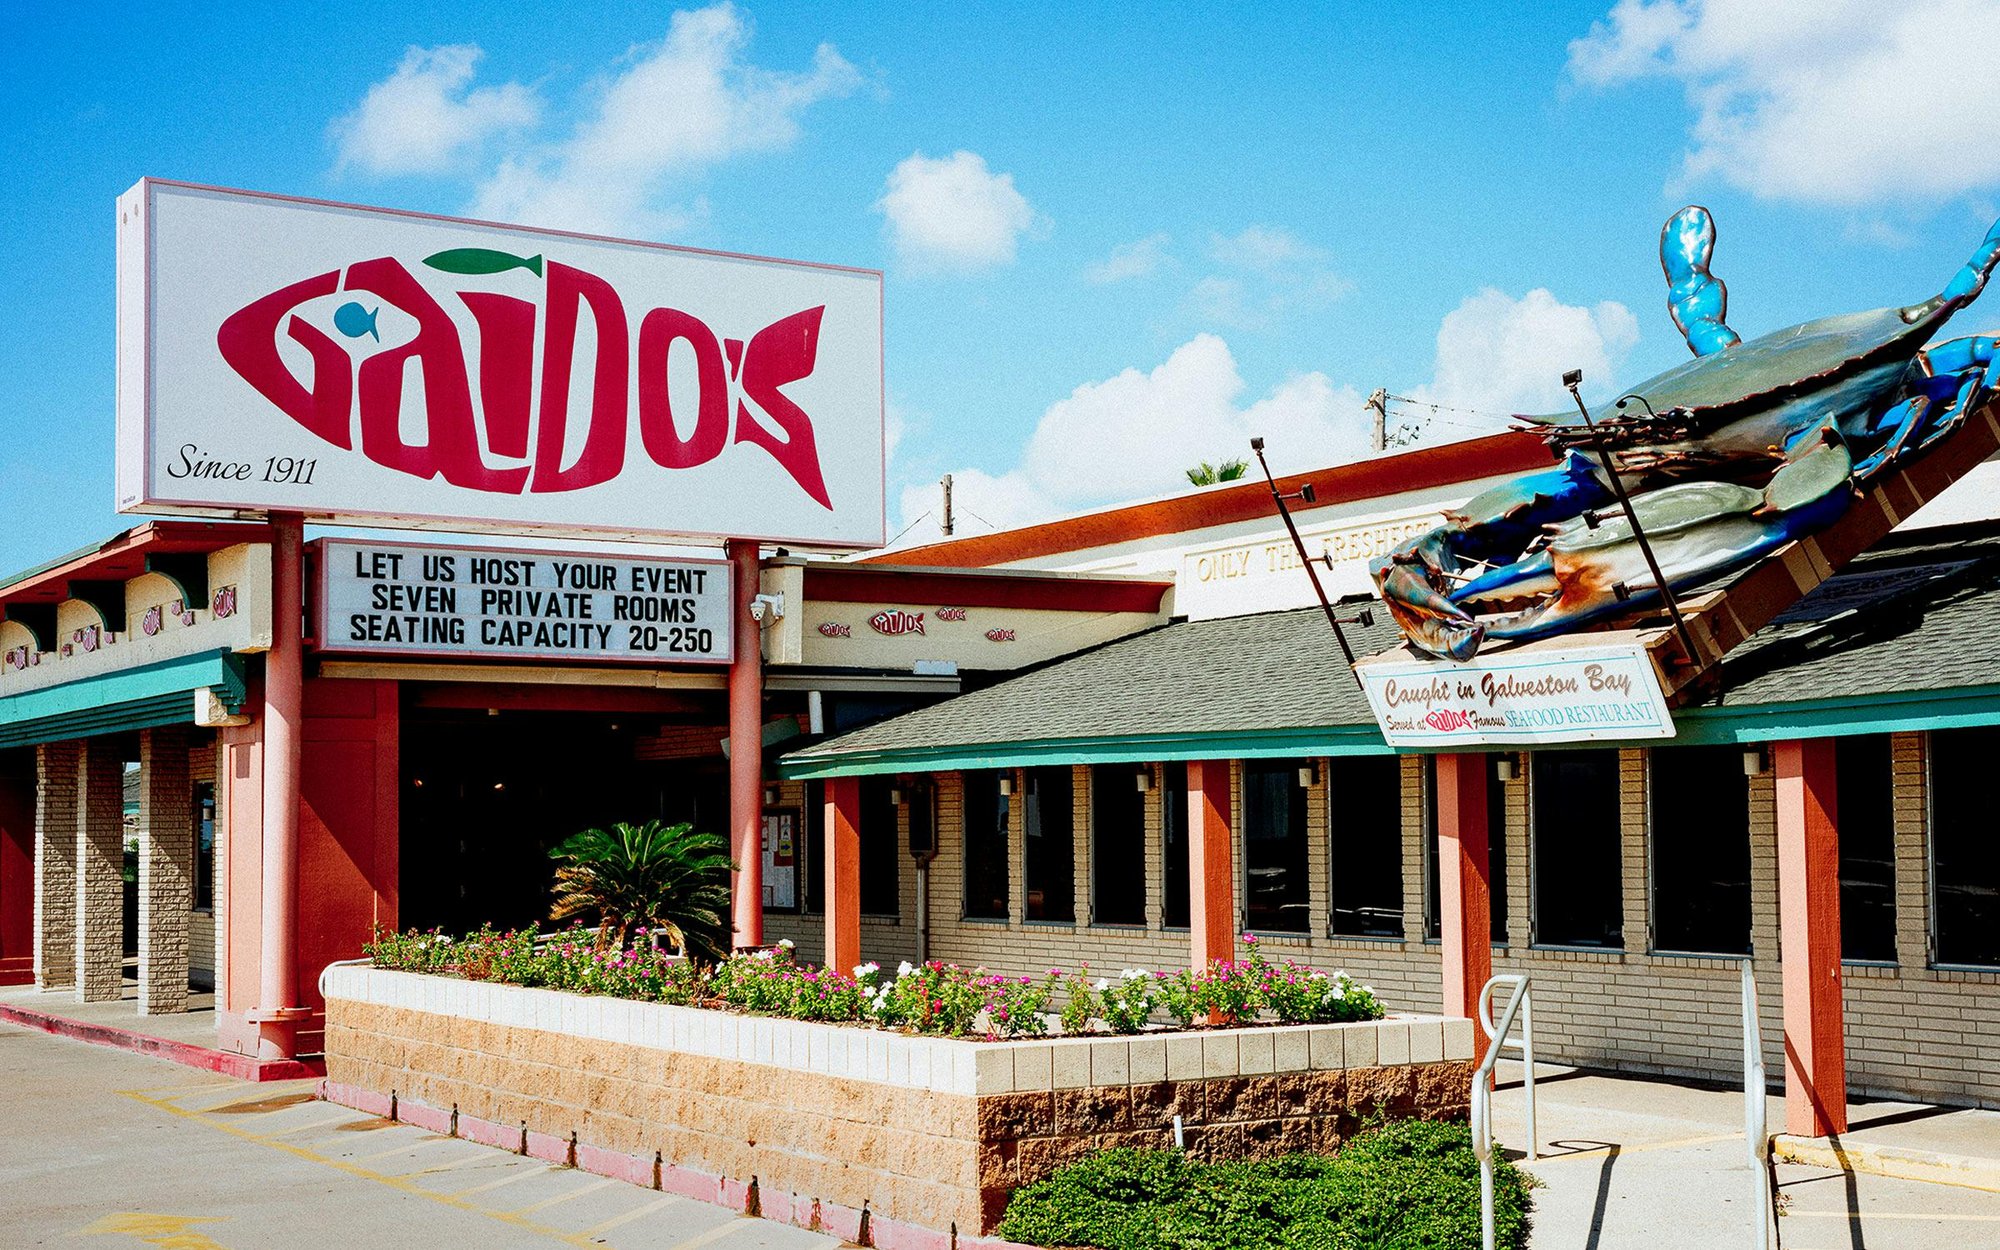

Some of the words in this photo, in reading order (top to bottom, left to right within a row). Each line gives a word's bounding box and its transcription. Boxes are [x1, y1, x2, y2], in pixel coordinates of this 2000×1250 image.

[167, 443, 253, 481] Since
[259, 456, 318, 485] 1911
[356, 551, 403, 580] LET
[423, 555, 455, 582] US
[471, 558, 536, 587] HOST
[552, 562, 617, 591] YOUR
[631, 567, 707, 595] EVENT
[1197, 550, 1250, 582] ONLY
[1265, 543, 1307, 572] THE
[372, 583, 456, 614] SEVEN
[481, 589, 593, 619] PRIVATE
[614, 595, 696, 624] ROOMS
[350, 614, 465, 645] SEATING
[481, 619, 612, 650] CAPACITY
[629, 625, 713, 654] 20-250
[1385, 677, 1450, 709] Caught
[1457, 681, 1475, 700] in
[1481, 672, 1579, 708] Galveston
[1584, 664, 1632, 698] Bay
[1386, 714, 1415, 731] Served
[1416, 718, 1427, 731] at
[1468, 709, 1506, 730] Famous
[1505, 707, 1564, 728] SEAFOOD
[1563, 701, 1653, 724] RESTAURANT
